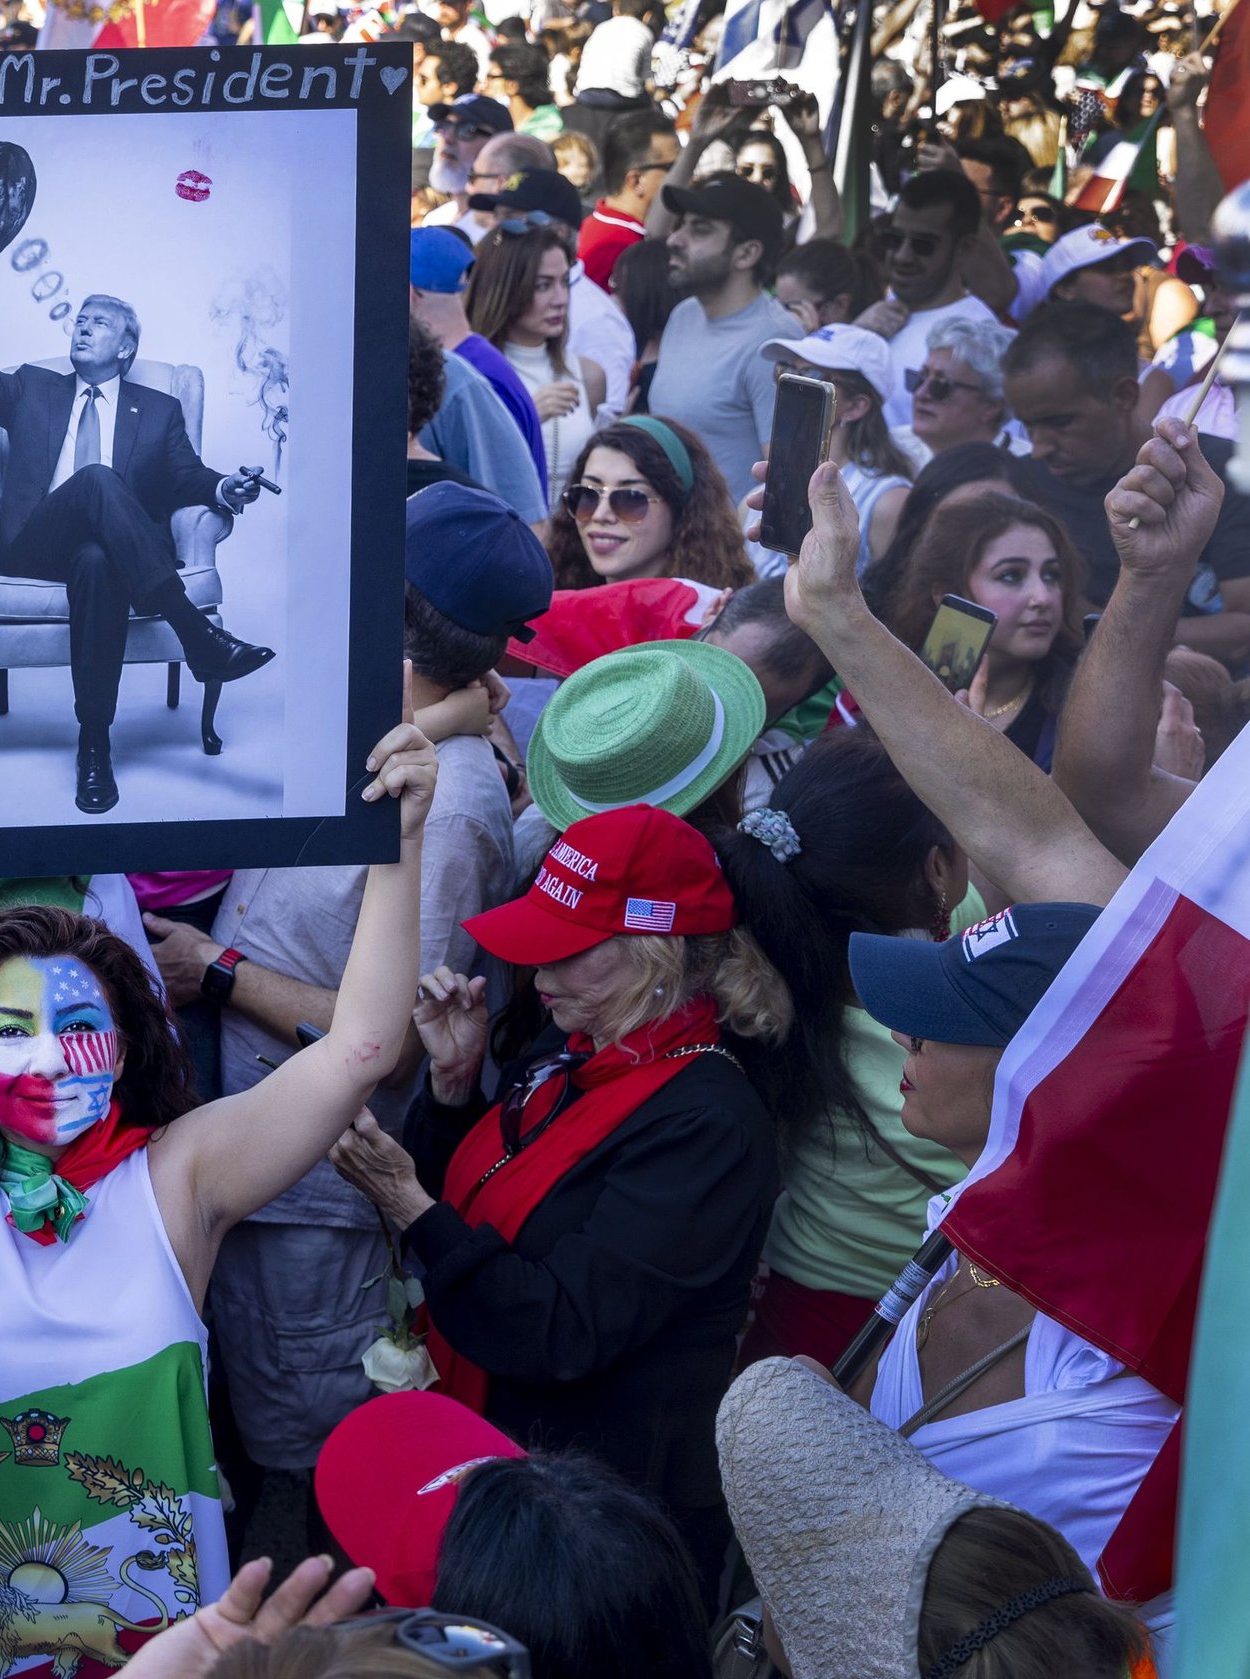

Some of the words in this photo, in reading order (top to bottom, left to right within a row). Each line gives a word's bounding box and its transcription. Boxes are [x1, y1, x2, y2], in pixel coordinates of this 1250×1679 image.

[82, 47, 377, 105] President
[551, 842, 599, 882] AMERICA
[539, 873, 584, 910] AGAIN
